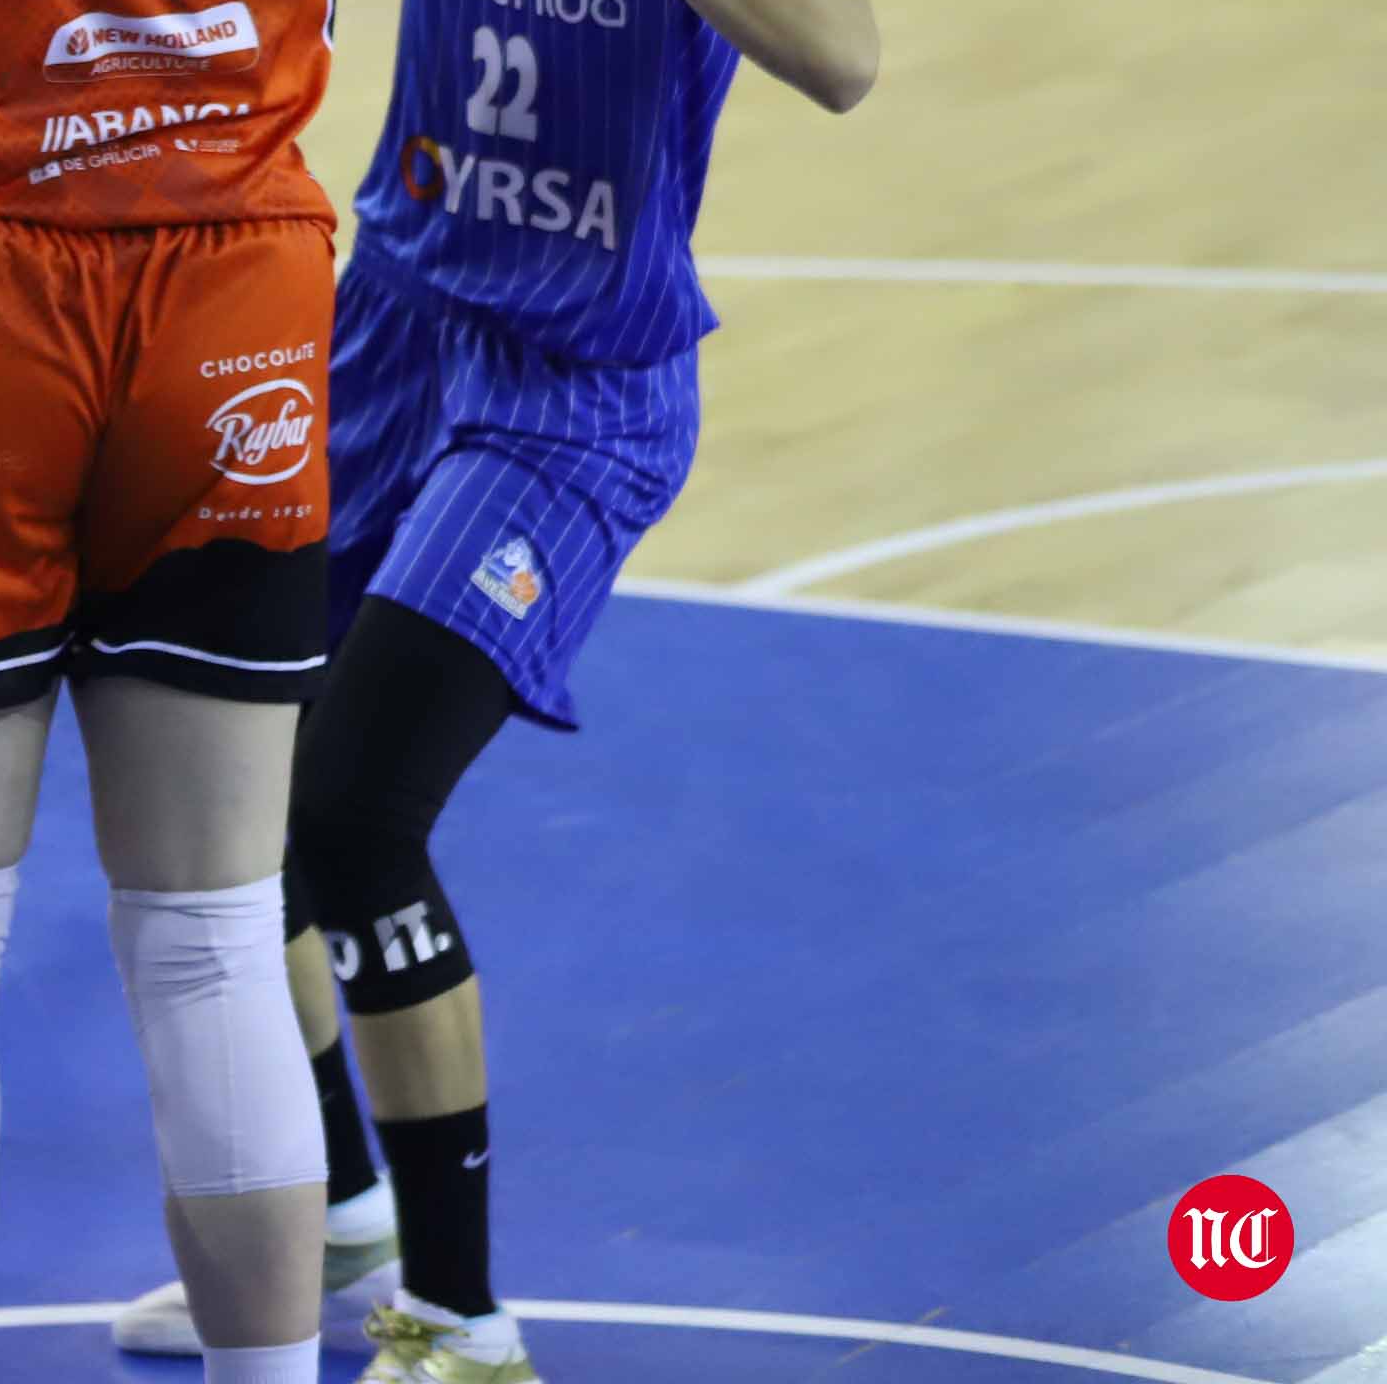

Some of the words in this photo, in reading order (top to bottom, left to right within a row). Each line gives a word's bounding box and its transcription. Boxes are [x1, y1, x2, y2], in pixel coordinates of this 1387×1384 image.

[92, 28, 138, 47] NEW
[146, 19, 237, 49] HOLLAND
[467, 25, 538, 142] 22
[200, 342, 316, 378] CHOCOLATE
[374, 900, 452, 973] IT.
